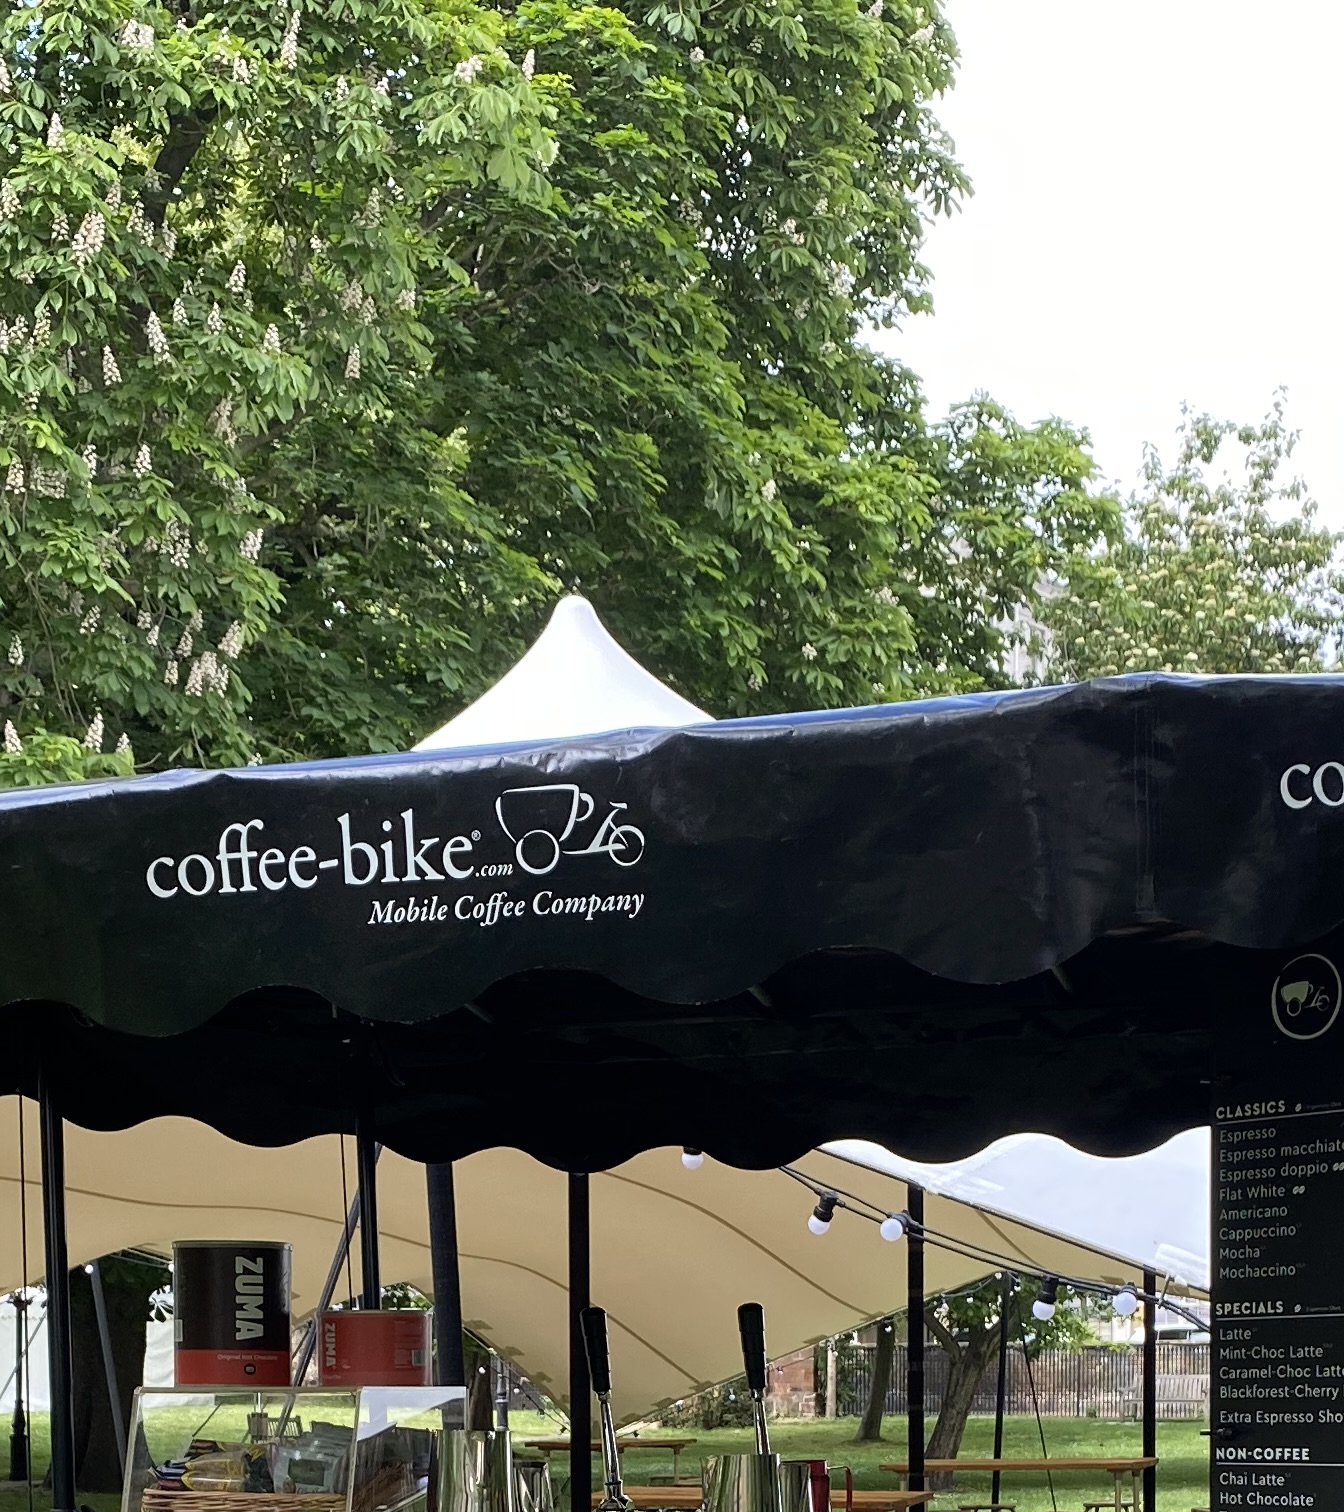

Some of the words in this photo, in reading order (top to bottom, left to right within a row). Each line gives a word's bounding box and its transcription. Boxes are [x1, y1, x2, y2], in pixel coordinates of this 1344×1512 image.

[368, 899, 448, 925] Mobile
[455, 894, 525, 927] Coffee
[532, 890, 644, 921] Company
[1216, 1100, 1285, 1119] CLASSICS
[1219, 1127, 1276, 1144] Espresso
[1219, 1146, 1276, 1164] Espresso
[1219, 1166, 1276, 1184] Espresso
[1280, 1160, 1328, 1178] doppio
[1219, 1188, 1242, 1202] Flat
[1247, 1185, 1285, 1200] White
[1219, 1205, 1287, 1221] Americano
[1219, 1224, 1296, 1242] Cappuccino
[1219, 1245, 1260, 1259] Mocha
[1219, 1263, 1296, 1280] Mochaccino
[234, 1256, 264, 1341] ZUMA
[1216, 1301, 1283, 1315] SPECIALS
[1220, 1328, 1251, 1341] Latte
[325, 1322, 336, 1367] ZUMA
[1220, 1345, 1285, 1360] Mint-Choc
[1290, 1346, 1323, 1359] Latte
[1220, 1365, 1311, 1379] Caramel-Choc
[1220, 1384, 1339, 1400] Blackforest-Cherry
[1220, 1411, 1251, 1423] Extra
[1256, 1410, 1314, 1426] Espresso
[1215, 1447, 1310, 1460] NON-COFFEE
[1219, 1472, 1248, 1486] Chai
[1252, 1473, 1285, 1486] Latte
[1219, 1492, 1242, 1505] Hot
[1247, 1492, 1314, 1507] Chocolate
